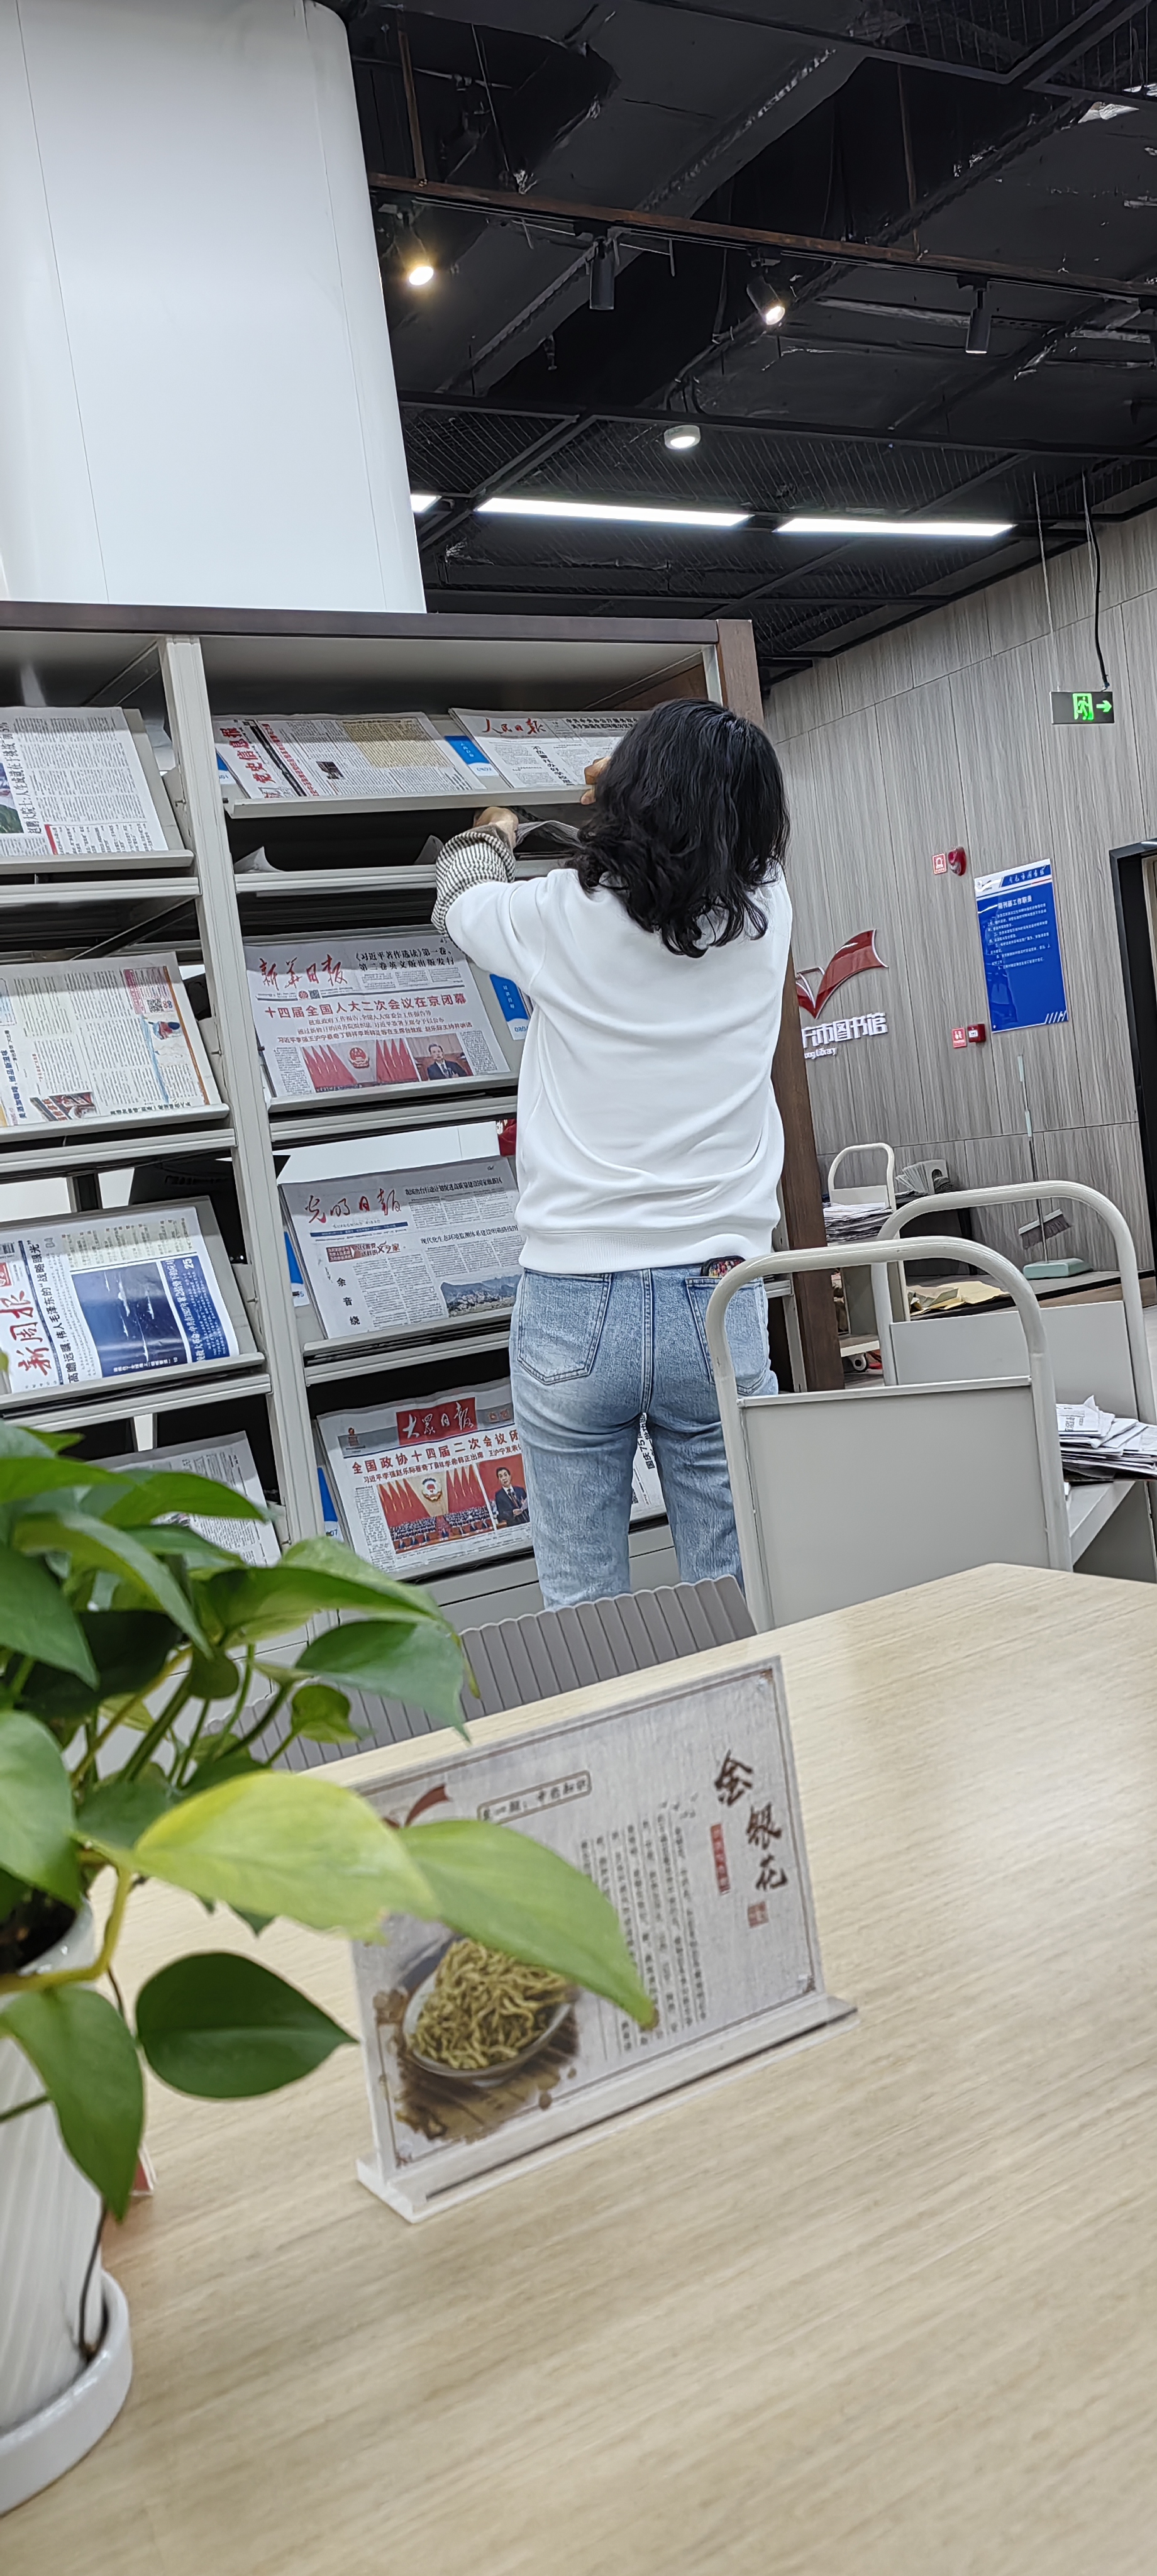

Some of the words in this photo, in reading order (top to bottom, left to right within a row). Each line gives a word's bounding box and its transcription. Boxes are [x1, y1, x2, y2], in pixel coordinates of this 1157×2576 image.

[483, 717, 547, 735] 人民日报
[219, 726, 273, 784] 党史信息报
[258, 953, 349, 991] 新华日报
[265, 992, 467, 1020] 十四届全国人大二次会议在京闭幕
[304, 1187, 402, 1224] 光明日报
[184, 1258, 195, 1270] 25
[336, 1277, 360, 1326] 余音绕
[0, 1290, 52, 1376] 新周报
[714, 1748, 789, 1892] 金银花
